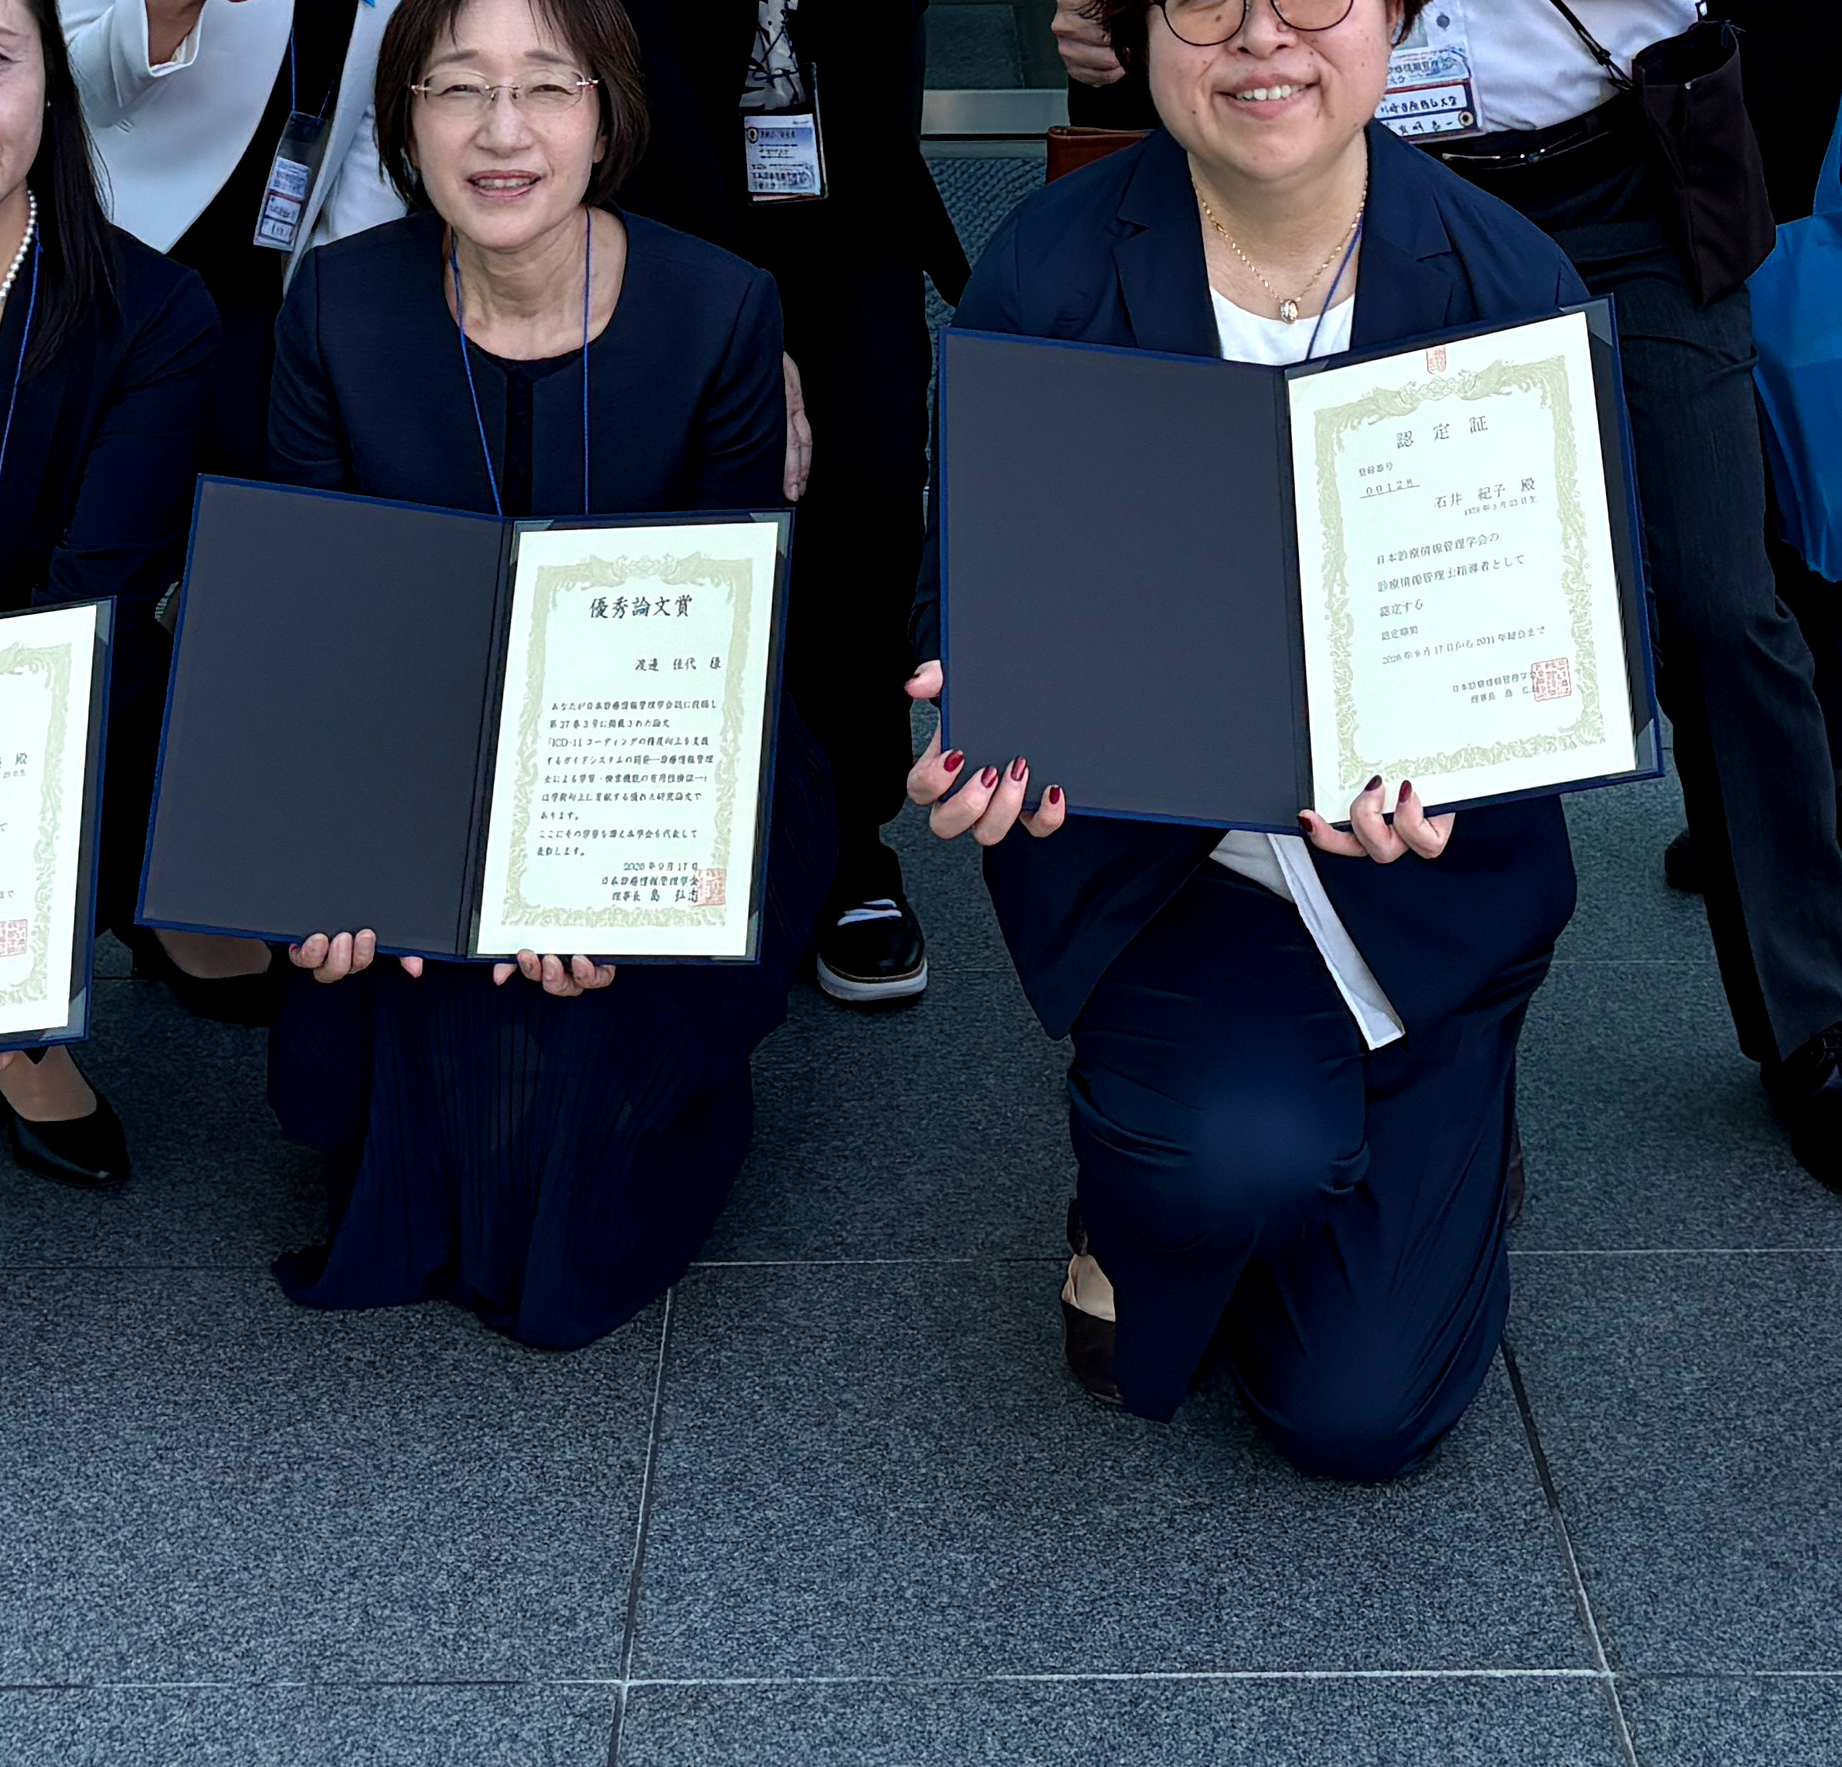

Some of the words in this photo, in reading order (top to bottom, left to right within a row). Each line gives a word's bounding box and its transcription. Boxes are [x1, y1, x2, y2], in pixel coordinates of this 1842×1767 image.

[589, 594, 693, 619] 優秀論文賞
